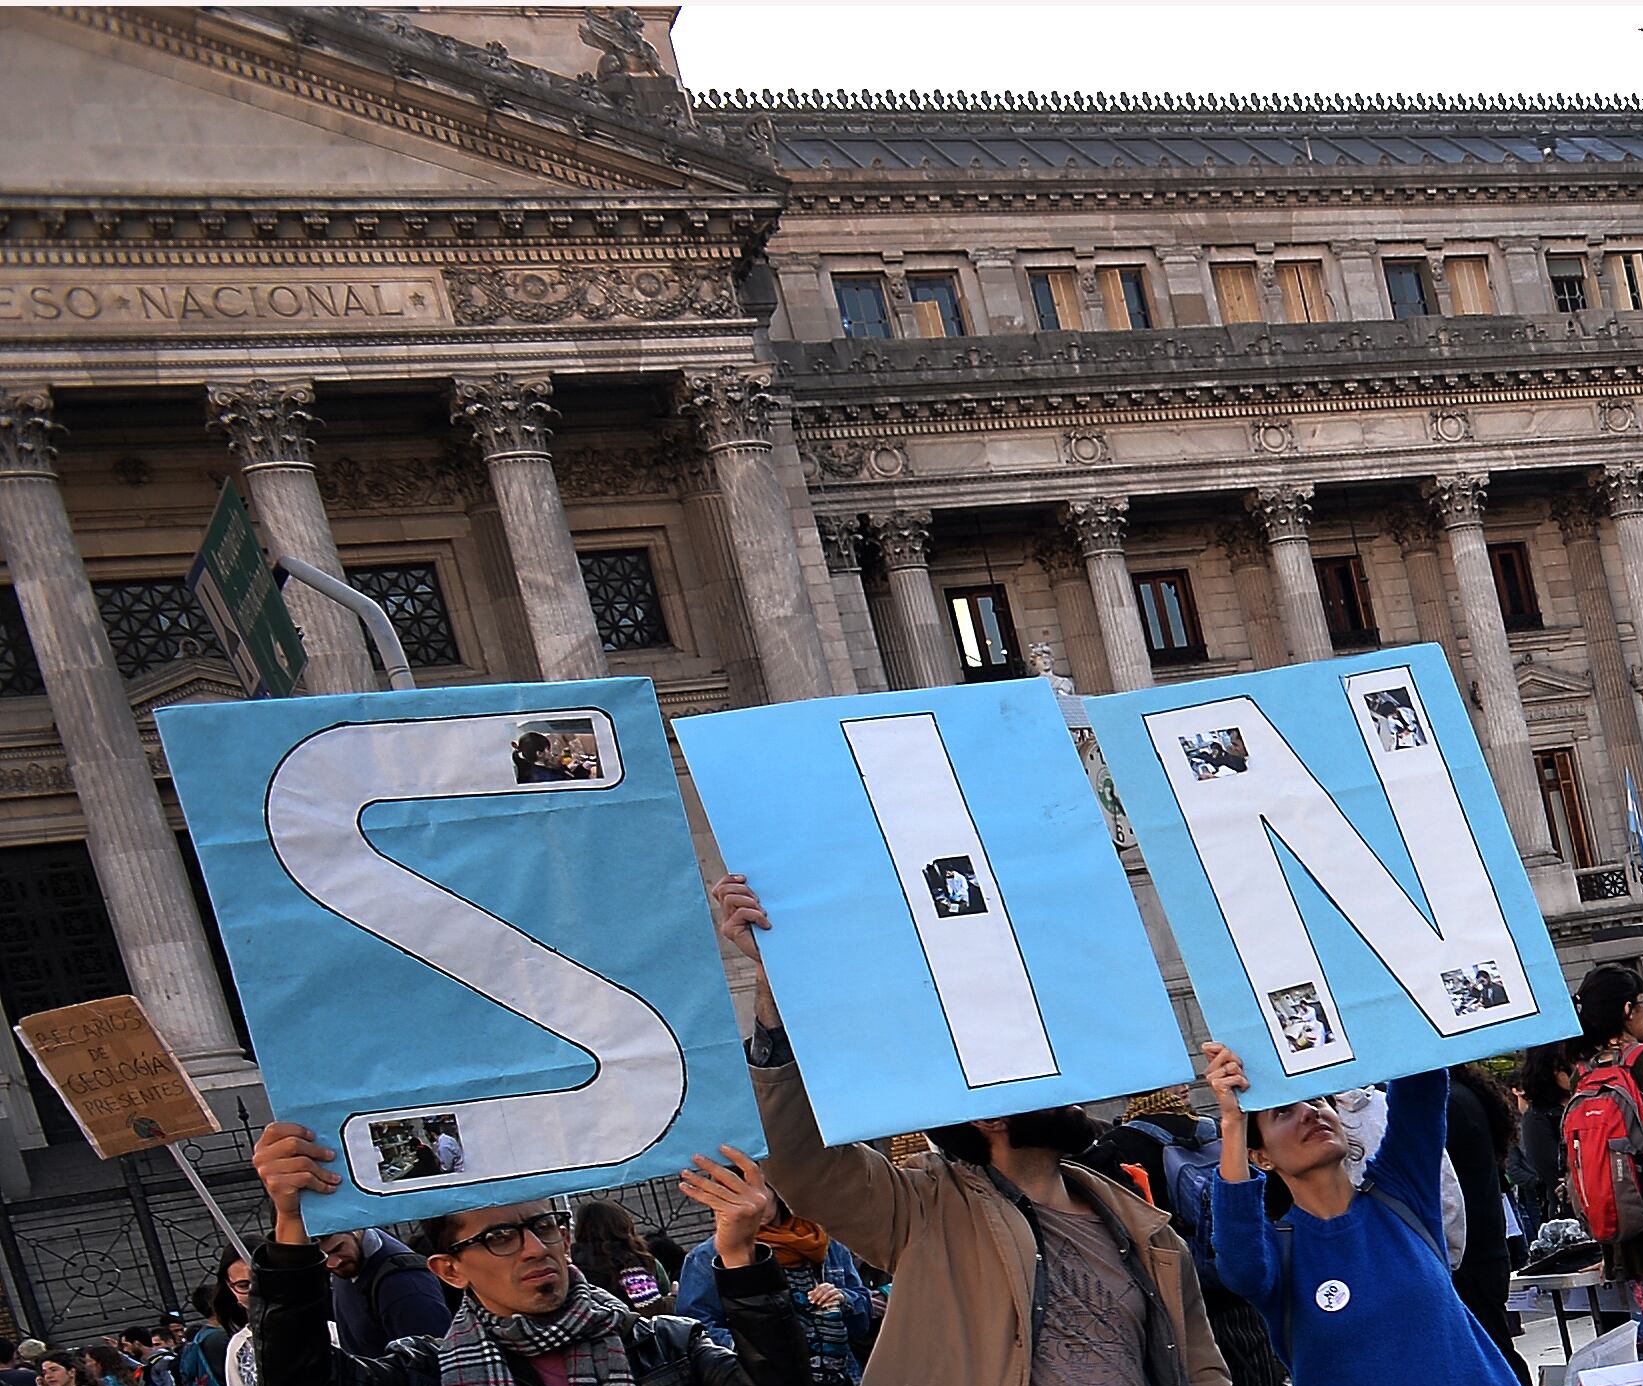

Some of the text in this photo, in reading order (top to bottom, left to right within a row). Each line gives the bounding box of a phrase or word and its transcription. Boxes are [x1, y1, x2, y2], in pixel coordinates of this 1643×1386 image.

[138, 285, 404, 319] NACIONAL
[88, 1047, 110, 1063] DE
[66, 1052, 170, 1096] GEOLOGÍA
[83, 1079, 184, 1116] PRESENTES
